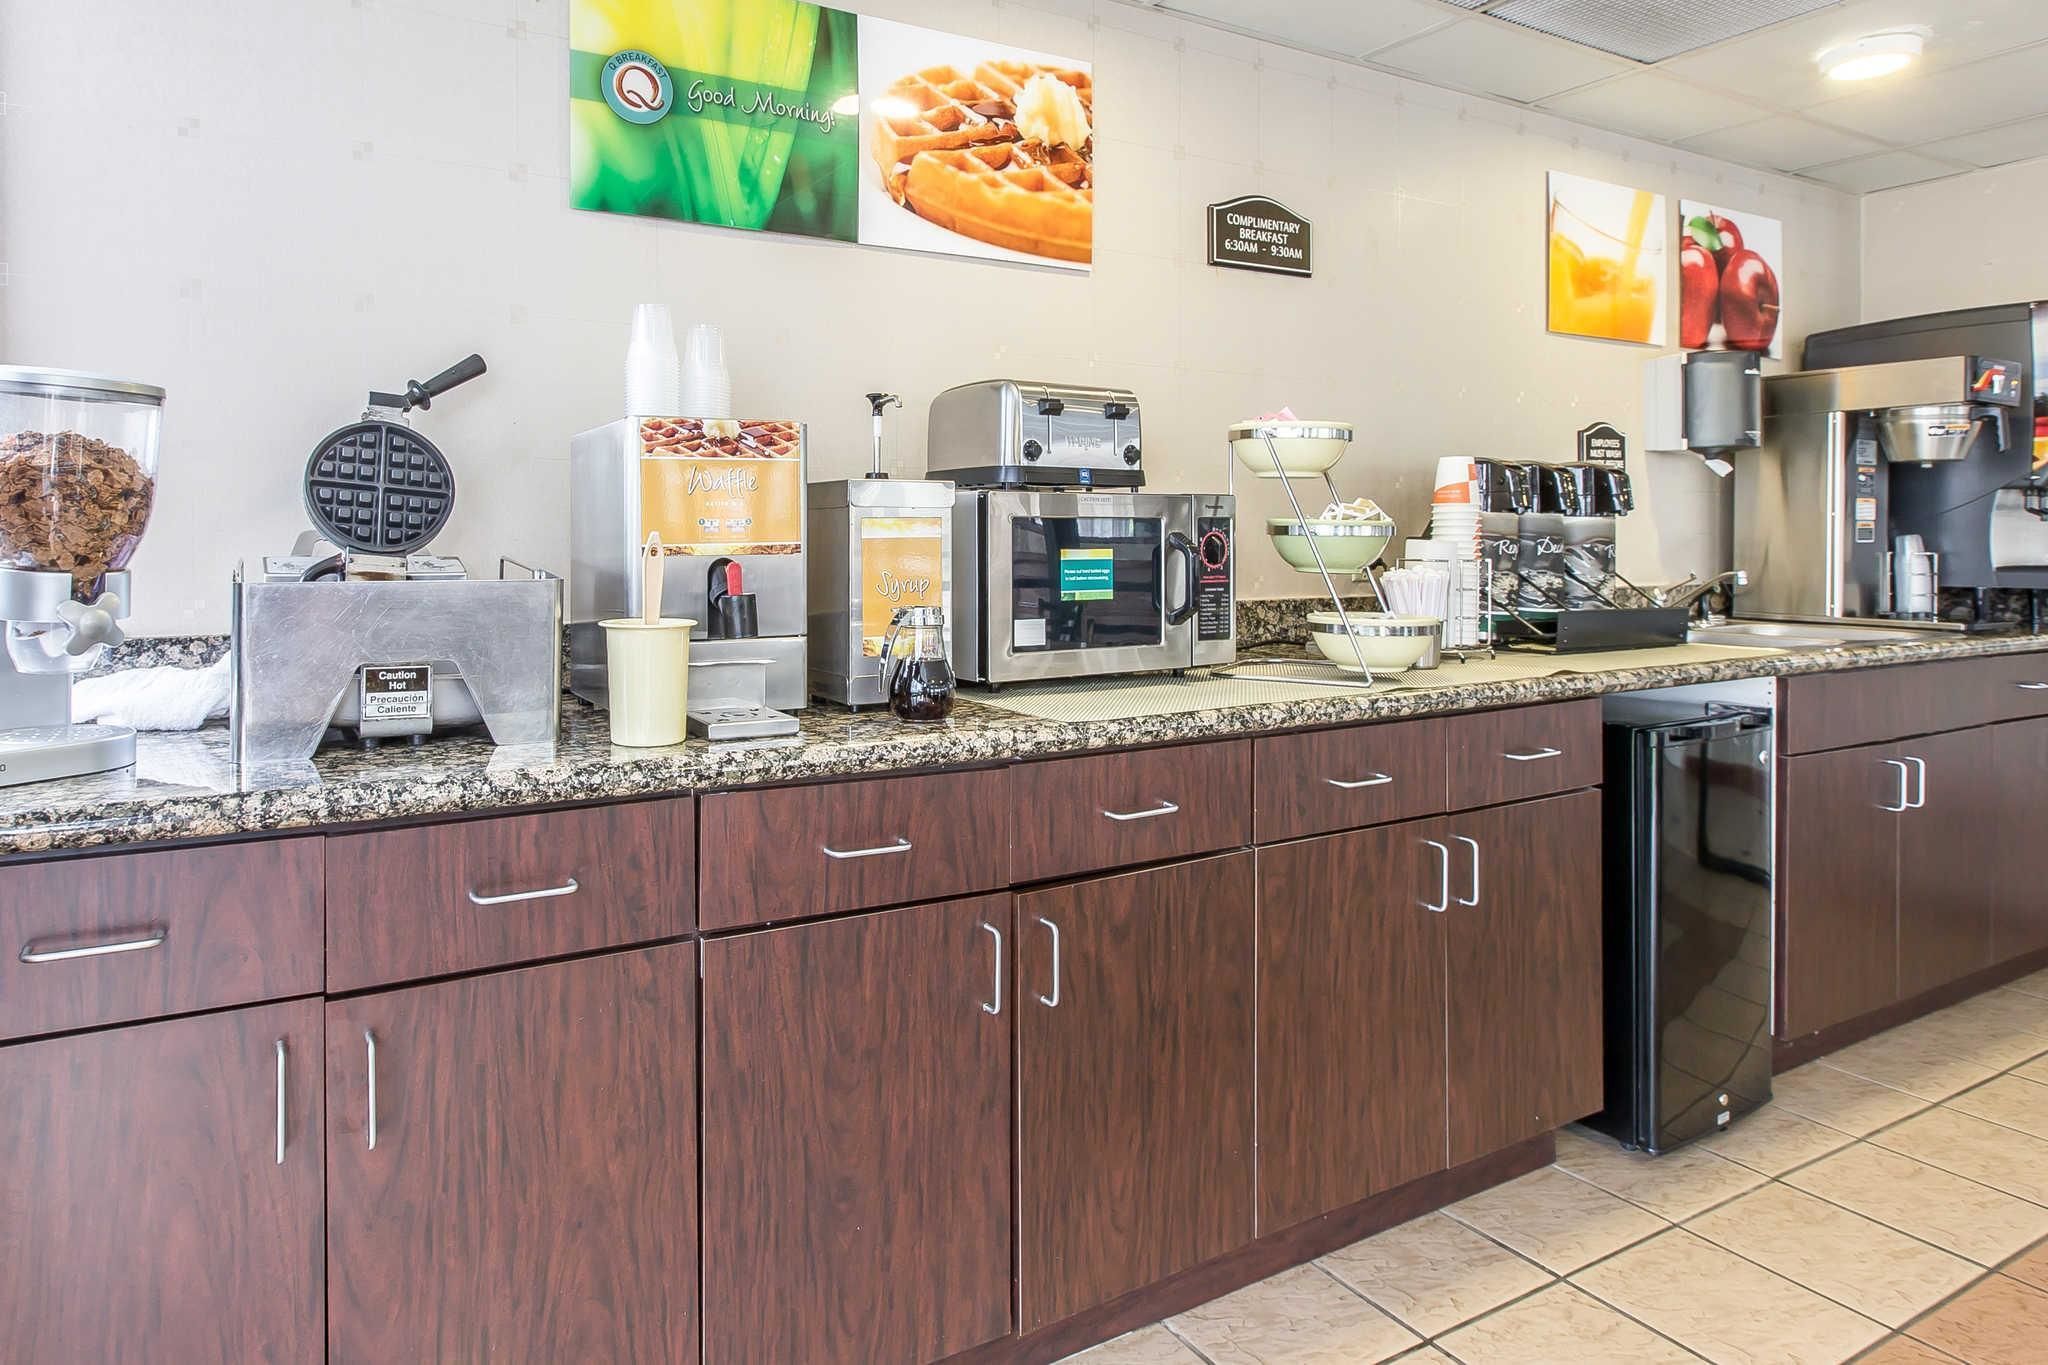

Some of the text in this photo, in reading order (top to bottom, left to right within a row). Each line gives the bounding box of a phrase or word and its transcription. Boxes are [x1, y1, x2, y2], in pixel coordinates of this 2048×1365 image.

[615, 51, 668, 79] BREAKFAST
[615, 65, 665, 111] Q
[687, 79, 837, 134] Good Morning!
[1226, 212, 1300, 234] COMPLIMENTARY
[1239, 227, 1289, 245] BREAKFAST
[1224, 238, 1258, 253] 6:30AM
[1270, 245, 1303, 260] 9:30AM
[687, 465, 758, 498] Waffle
[875, 569, 931, 602] Syrup
[379, 671, 416, 680] Caution
[389, 681, 406, 690] Hot
[370, 694, 424, 704] Precaución
[377, 704, 417, 714] Caliente
